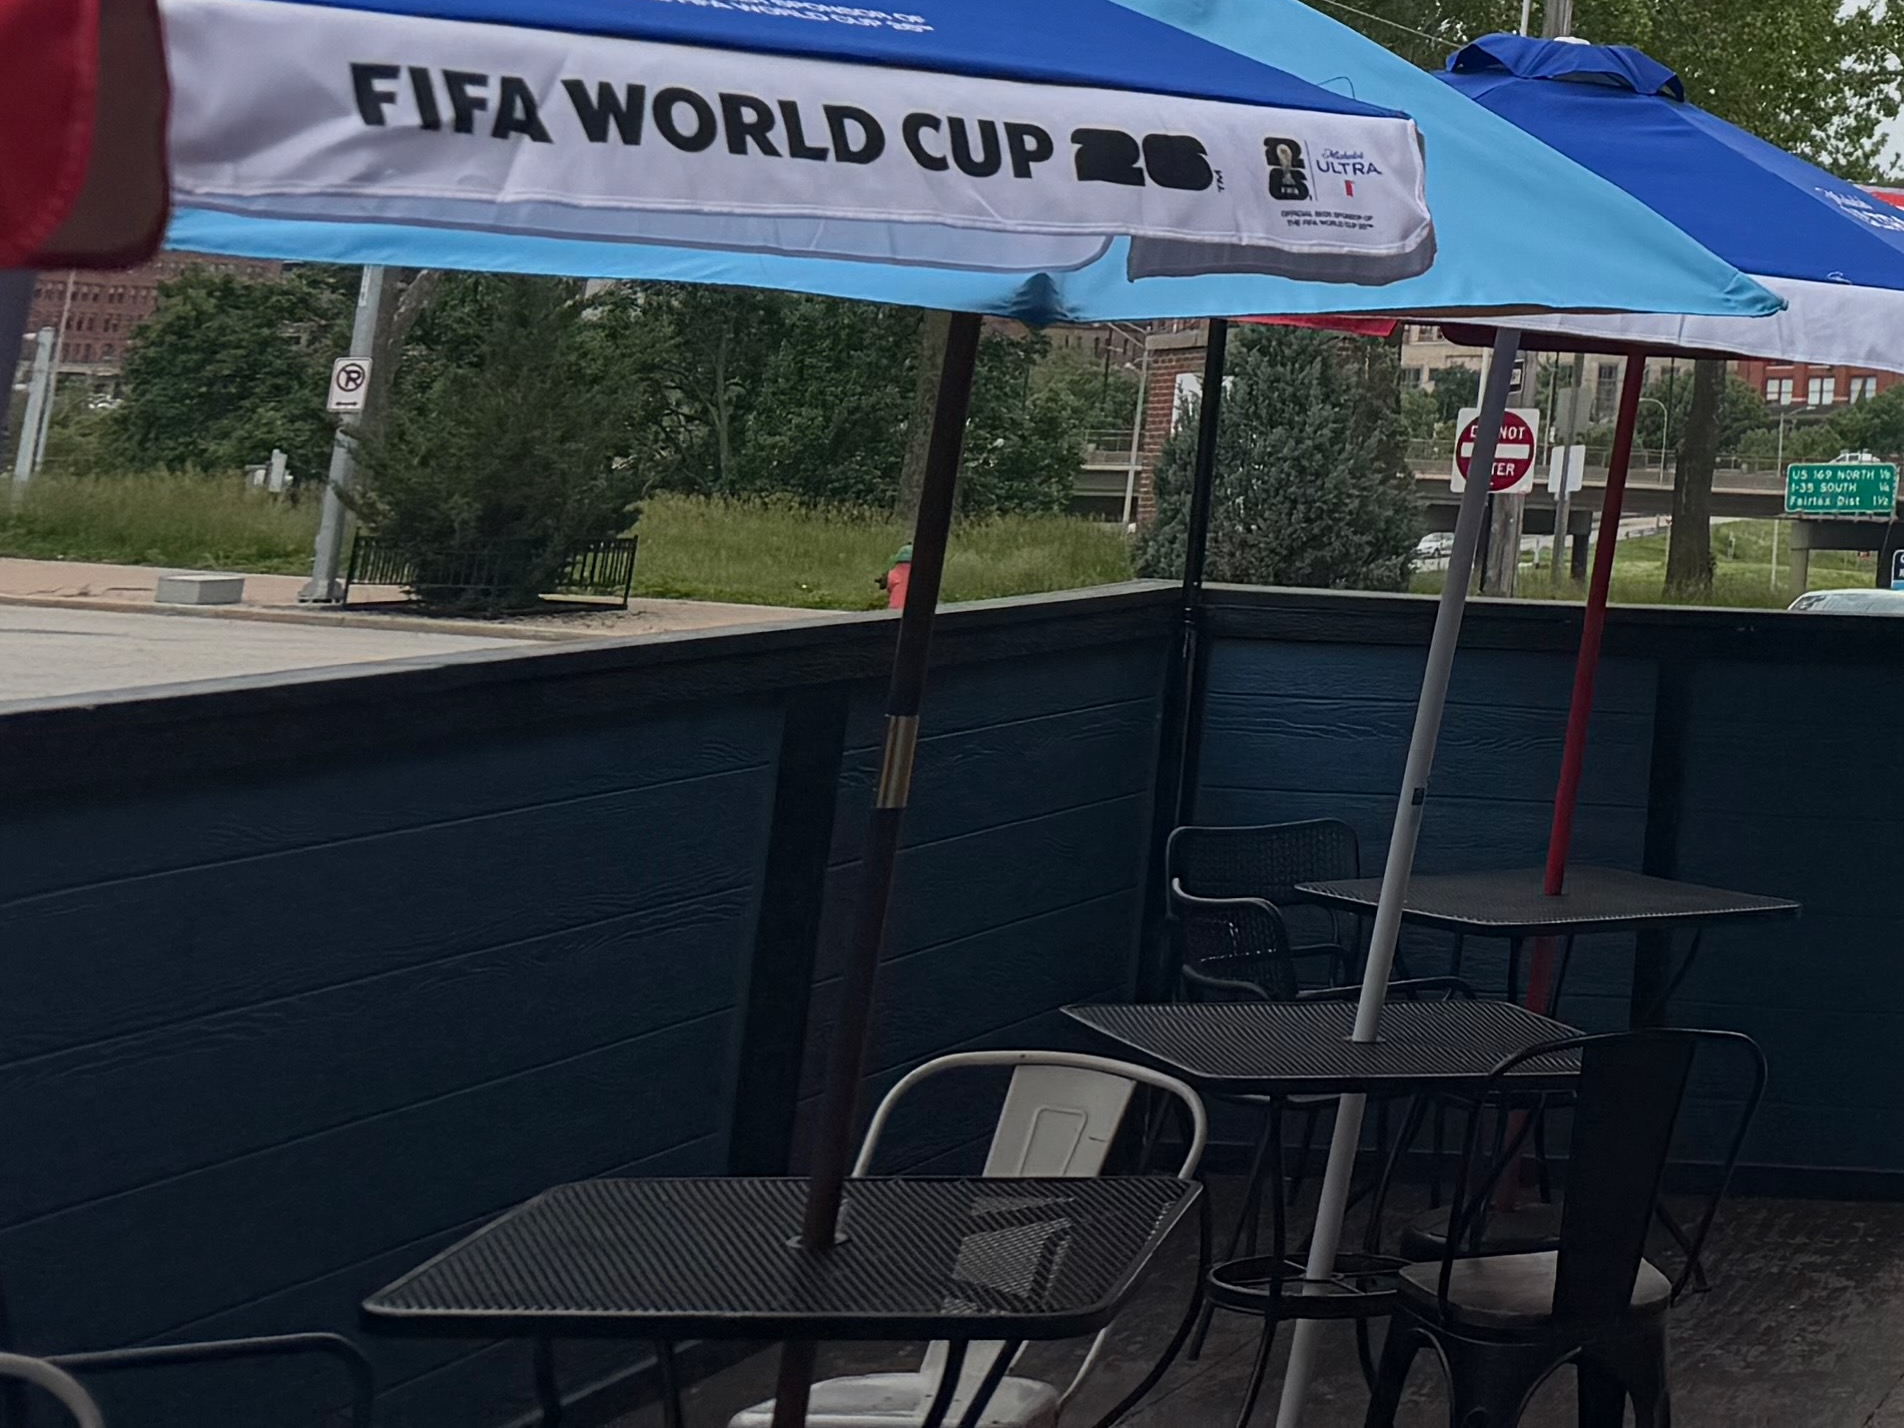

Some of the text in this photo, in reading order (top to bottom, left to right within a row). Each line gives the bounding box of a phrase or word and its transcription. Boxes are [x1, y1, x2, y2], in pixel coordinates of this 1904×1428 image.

[349, 62, 554, 144] FIFA
[560, 78, 886, 165] WORLD
[901, 111, 1055, 179] CUP
[1316, 159, 1383, 176] ULTRA
[1499, 426, 1526, 440] NOT
[1491, 462, 1515, 476] TER
[1792, 470, 1808, 480] US
[1813, 470, 1833, 480] 169
[1837, 470, 1875, 480] NORTH
[1819, 482, 1857, 493] SOUTH
[1789, 496, 1831, 506] Fairfax
[1836, 496, 1861, 506] Dist
